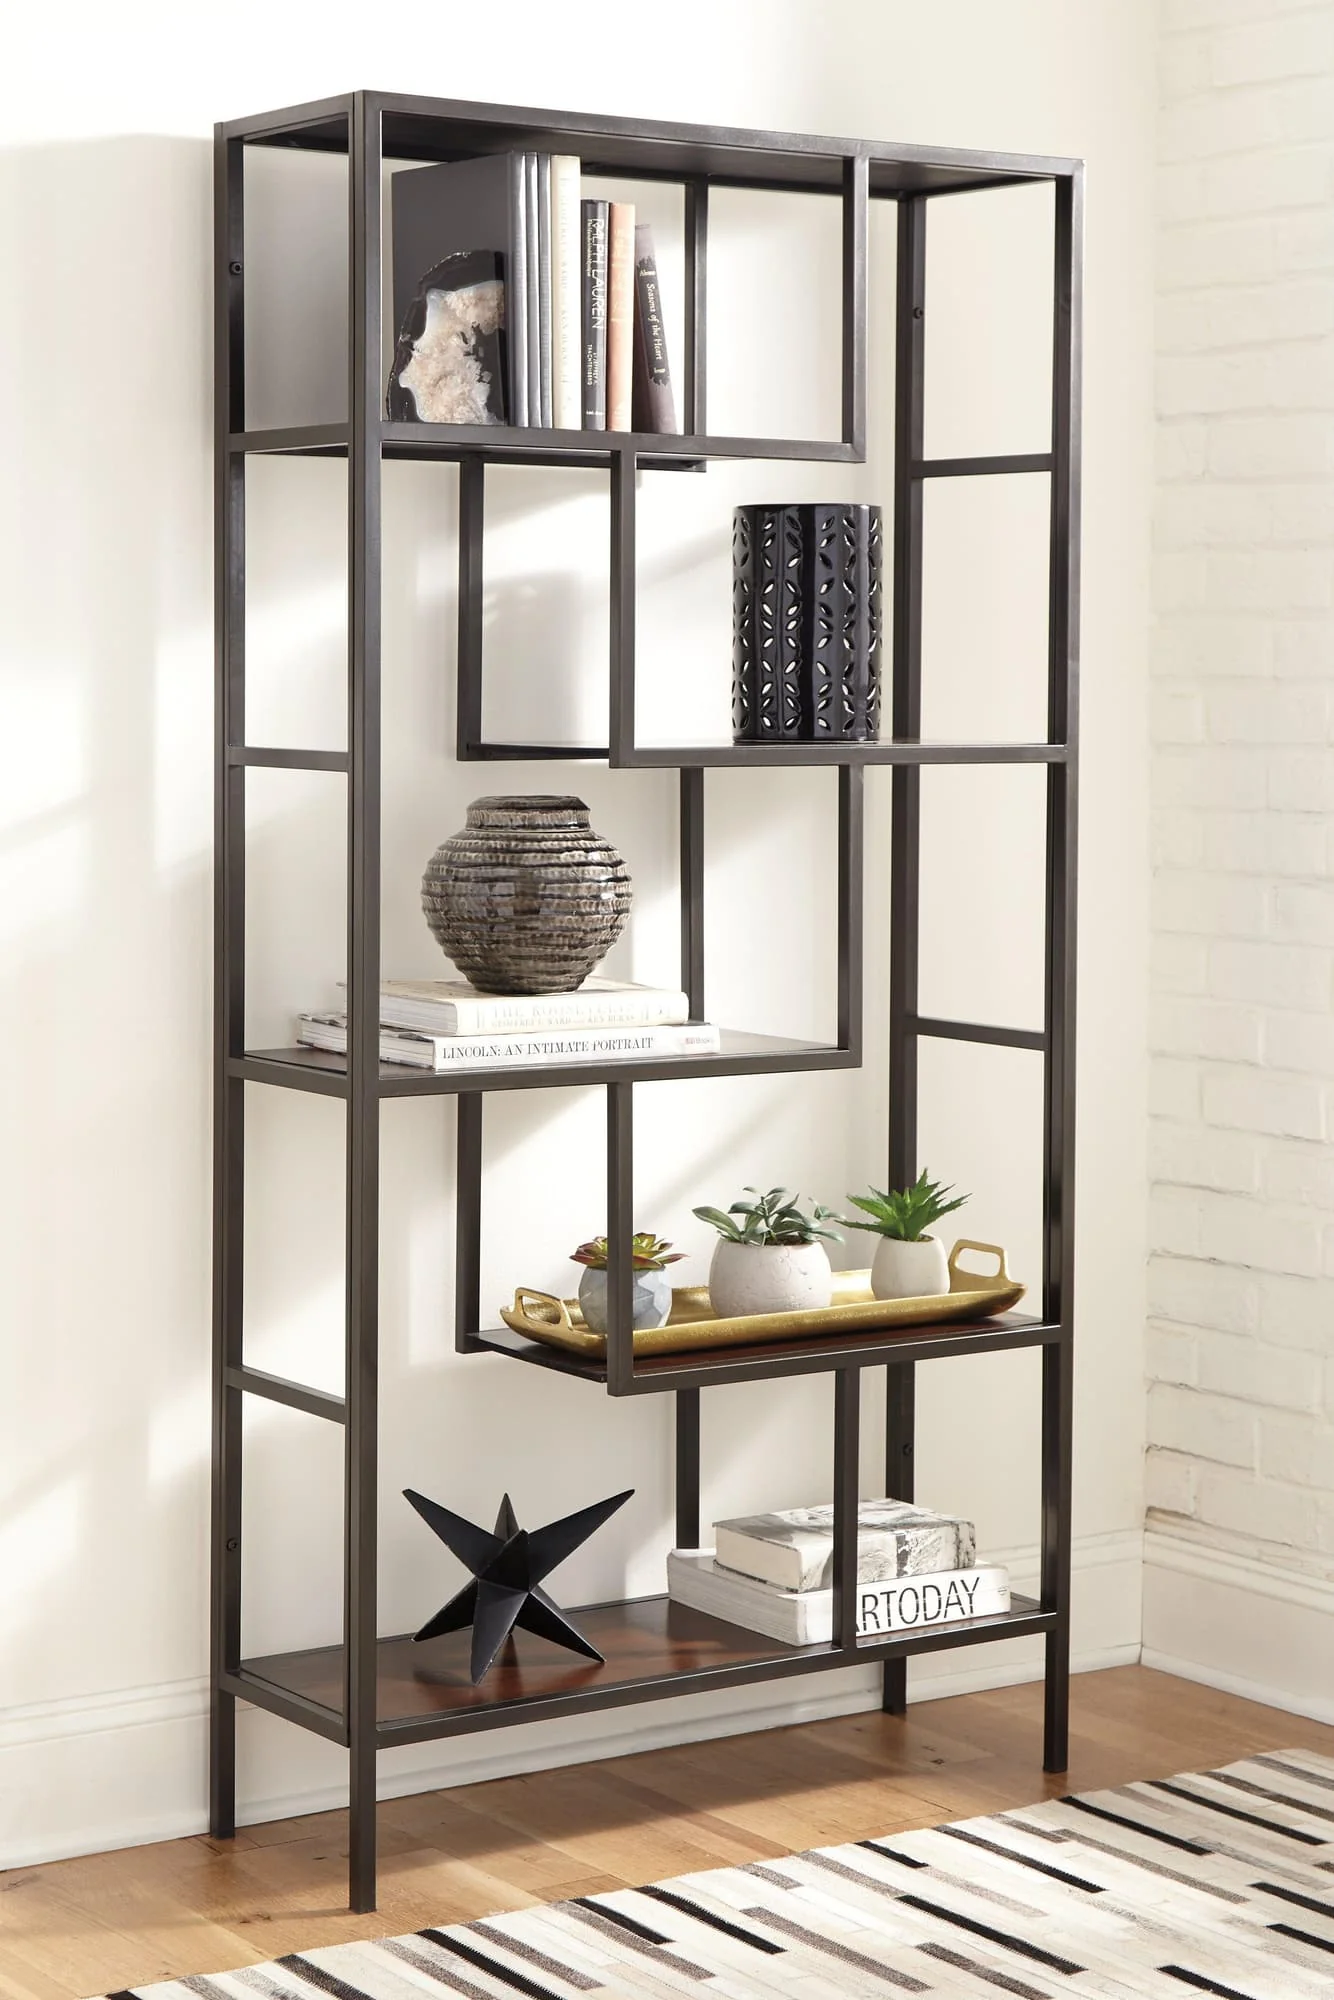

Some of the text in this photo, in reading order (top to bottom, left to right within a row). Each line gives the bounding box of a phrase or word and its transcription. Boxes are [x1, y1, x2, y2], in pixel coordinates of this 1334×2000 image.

[591, 218, 605, 330] RALPH LAUREN
[646, 283, 656, 313] Seasons
[648, 314, 660, 324] of
[651, 325, 661, 336] the
[653, 338, 663, 360] Heart
[442, 1037, 654, 1060] LINCOLN: AN INTIMATE PORTRAIT
[856, 1576, 980, 1633] RTODAY
